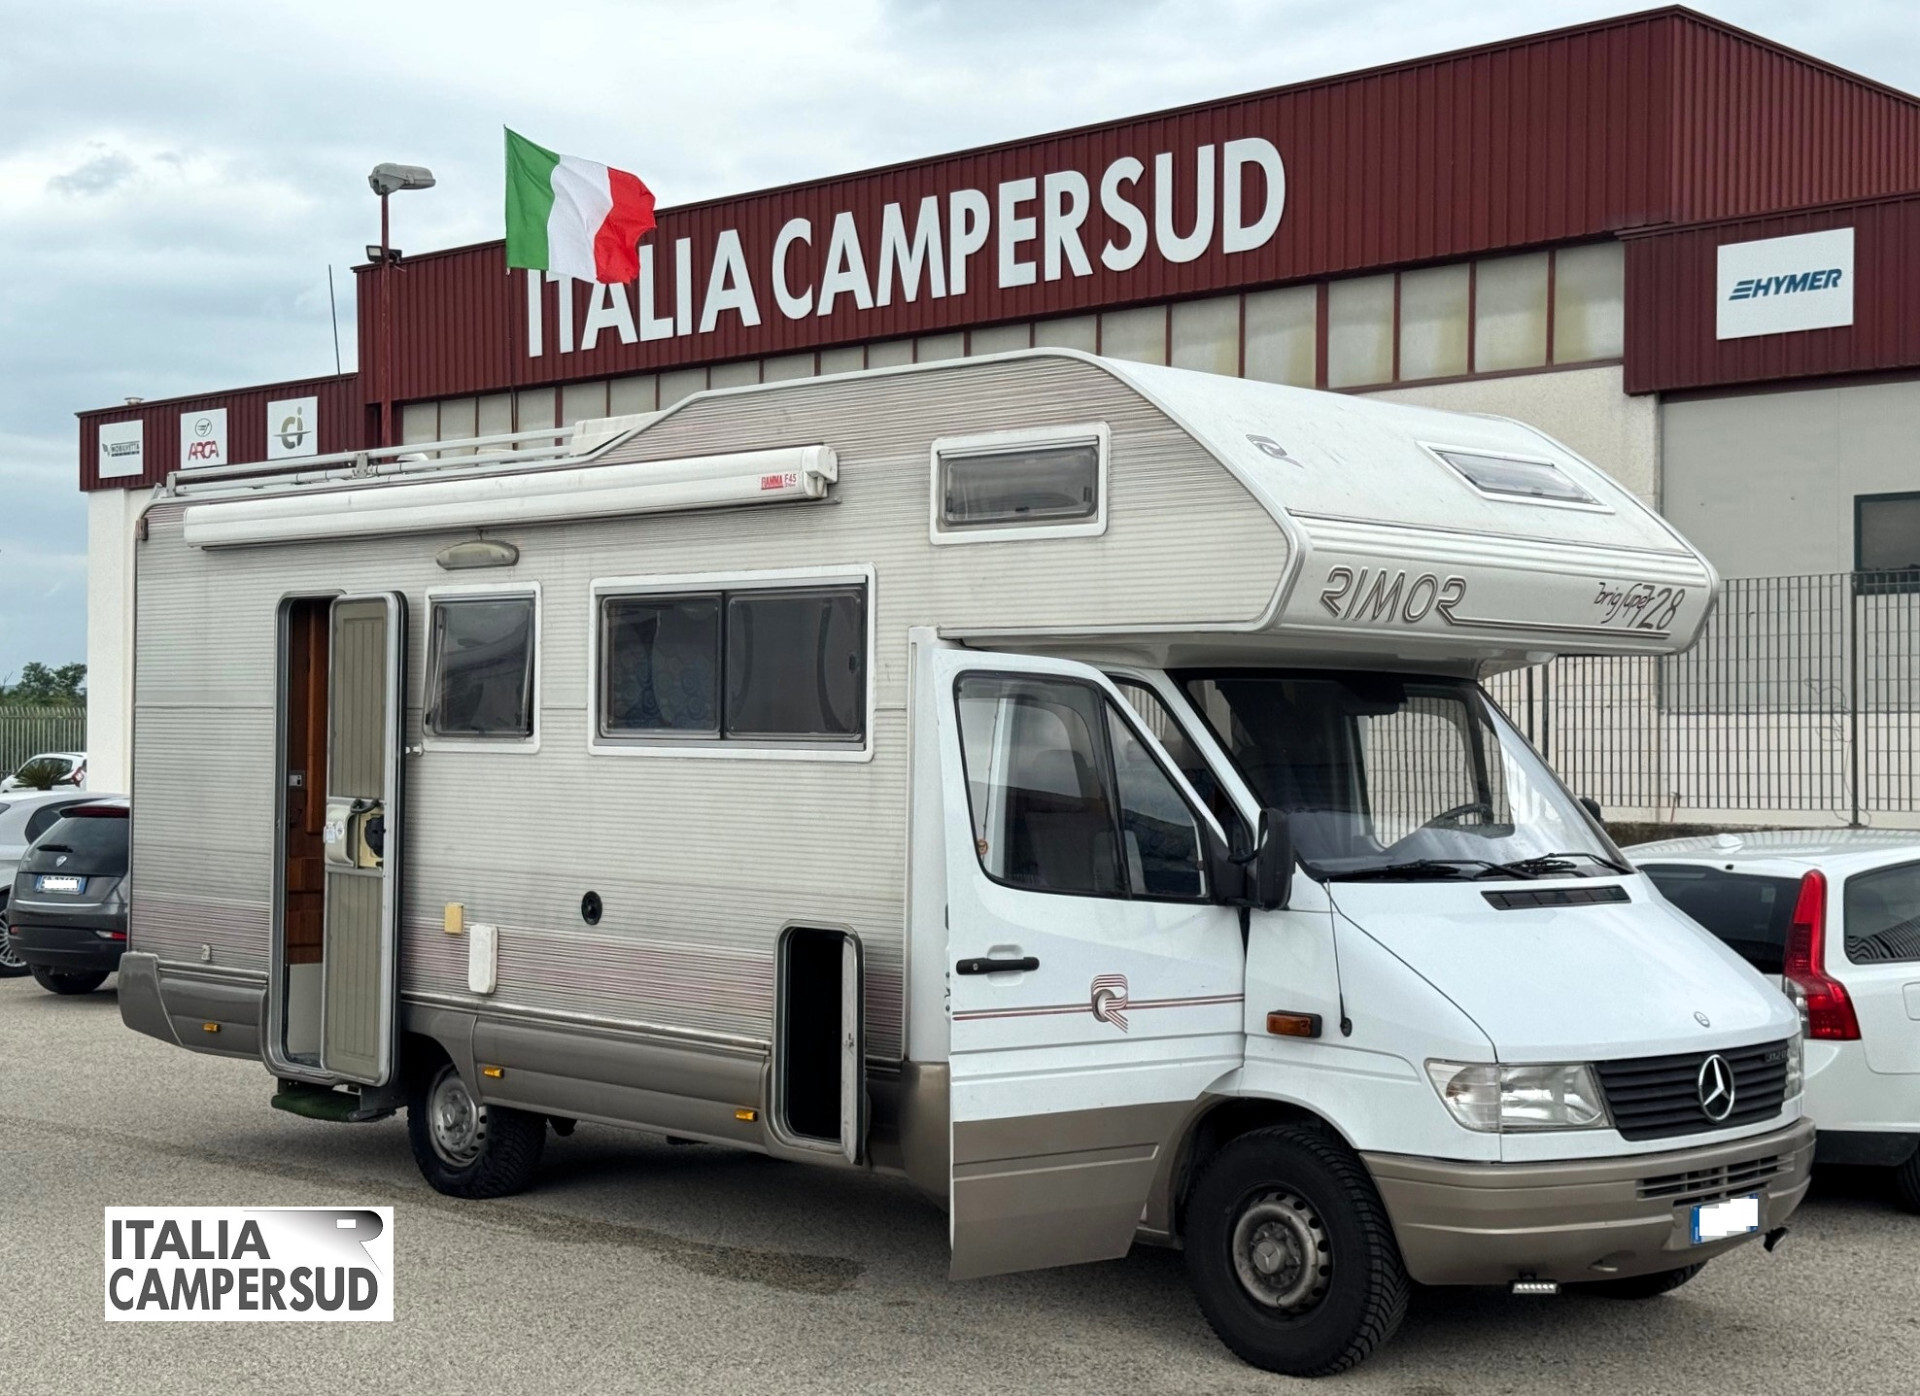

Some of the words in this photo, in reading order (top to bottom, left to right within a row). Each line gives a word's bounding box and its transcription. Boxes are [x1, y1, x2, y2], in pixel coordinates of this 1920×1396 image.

[527, 229, 762, 358] ITALIA
[772, 137, 1286, 320] CAMPERSUD
[1751, 268, 1843, 298] HYMER
[188, 441, 219, 461] ARCA
[784, 473, 797, 483] F45
[1320, 564, 1467, 626] RIMOR
